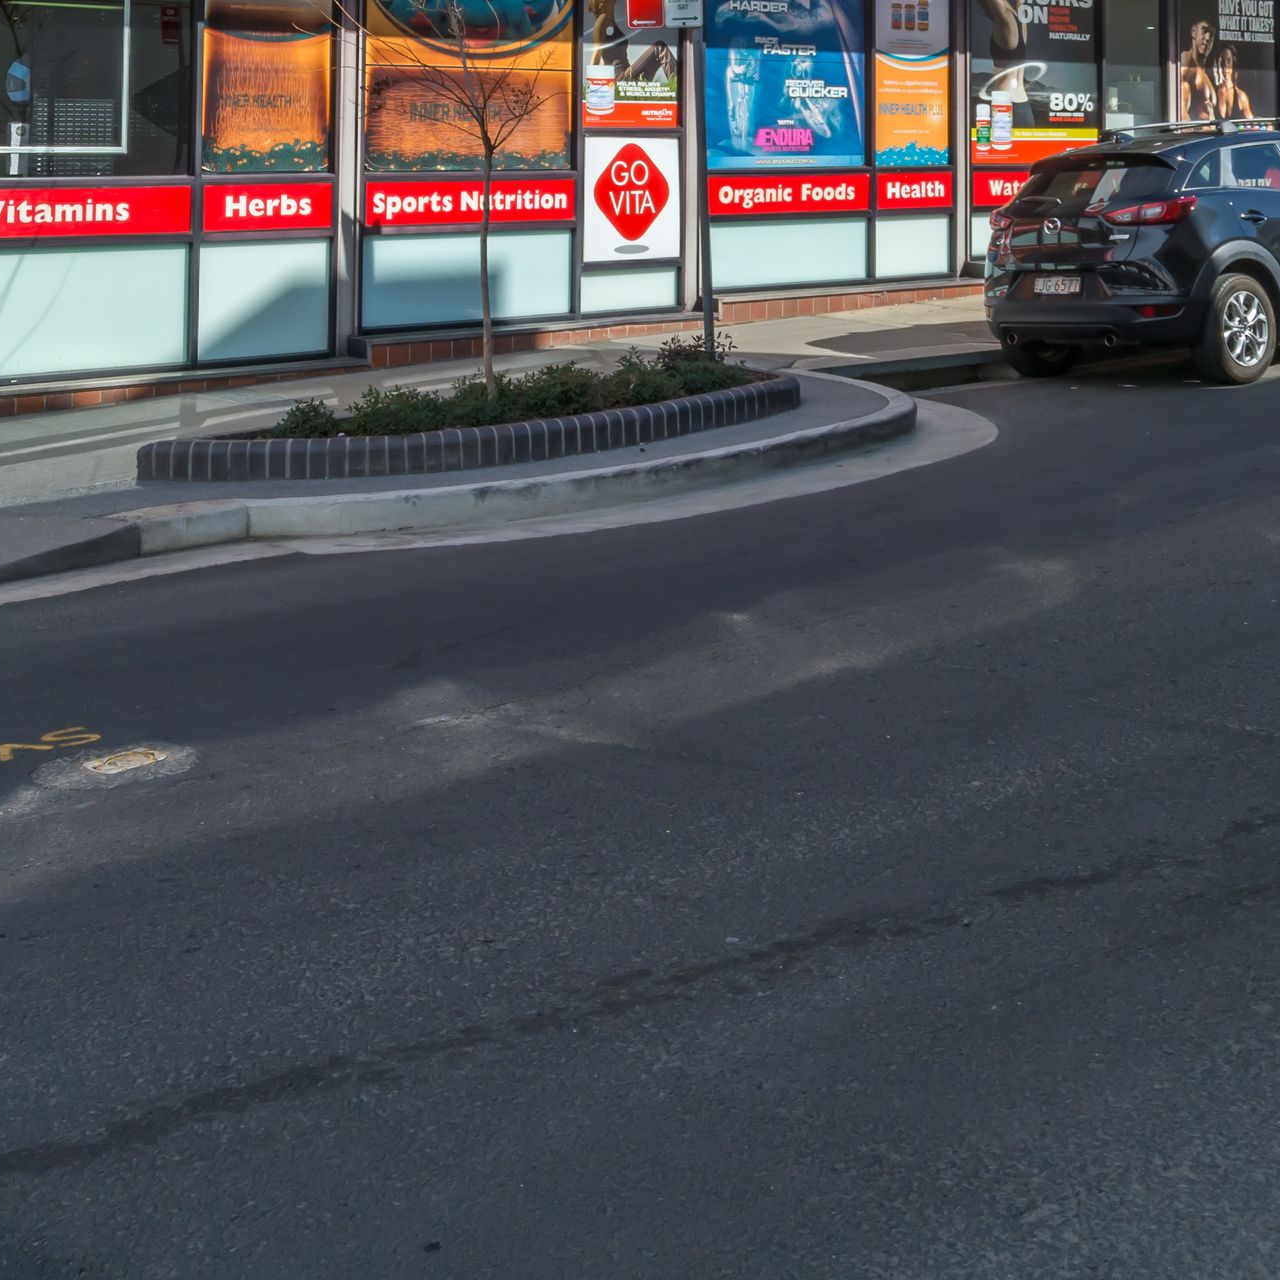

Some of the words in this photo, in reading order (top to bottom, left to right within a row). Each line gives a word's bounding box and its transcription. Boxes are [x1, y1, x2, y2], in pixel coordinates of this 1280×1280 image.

[729, 0, 788, 13] HARDER
[1017, 5, 1048, 24] ON
[1241, 0, 1257, 16] YOU
[1258, 0, 1274, 17] GOT
[1219, 15, 1240, 31] WHAT
[1240, 16, 1247, 31] IT
[1248, 17, 1274, 32] TAKES?
[754, 36, 778, 44] RACE
[1049, 32, 1090, 41] NATURALLY
[763, 44, 817, 56] FASTER
[785, 80, 825, 88] RECOVER
[788, 86, 848, 98] QUICKER
[879, 103, 899, 115] INNER
[900, 103, 928, 115] HEALTH
[1049, 92, 1094, 111] 80%
[611, 159, 649, 186] GO
[718, 184, 793, 209] Organic
[800, 182, 856, 202] Foods
[886, 179, 945, 199] Health
[224, 193, 313, 218] Herbs
[372, 190, 454, 220] Sports
[608, 189, 657, 216] VITA
